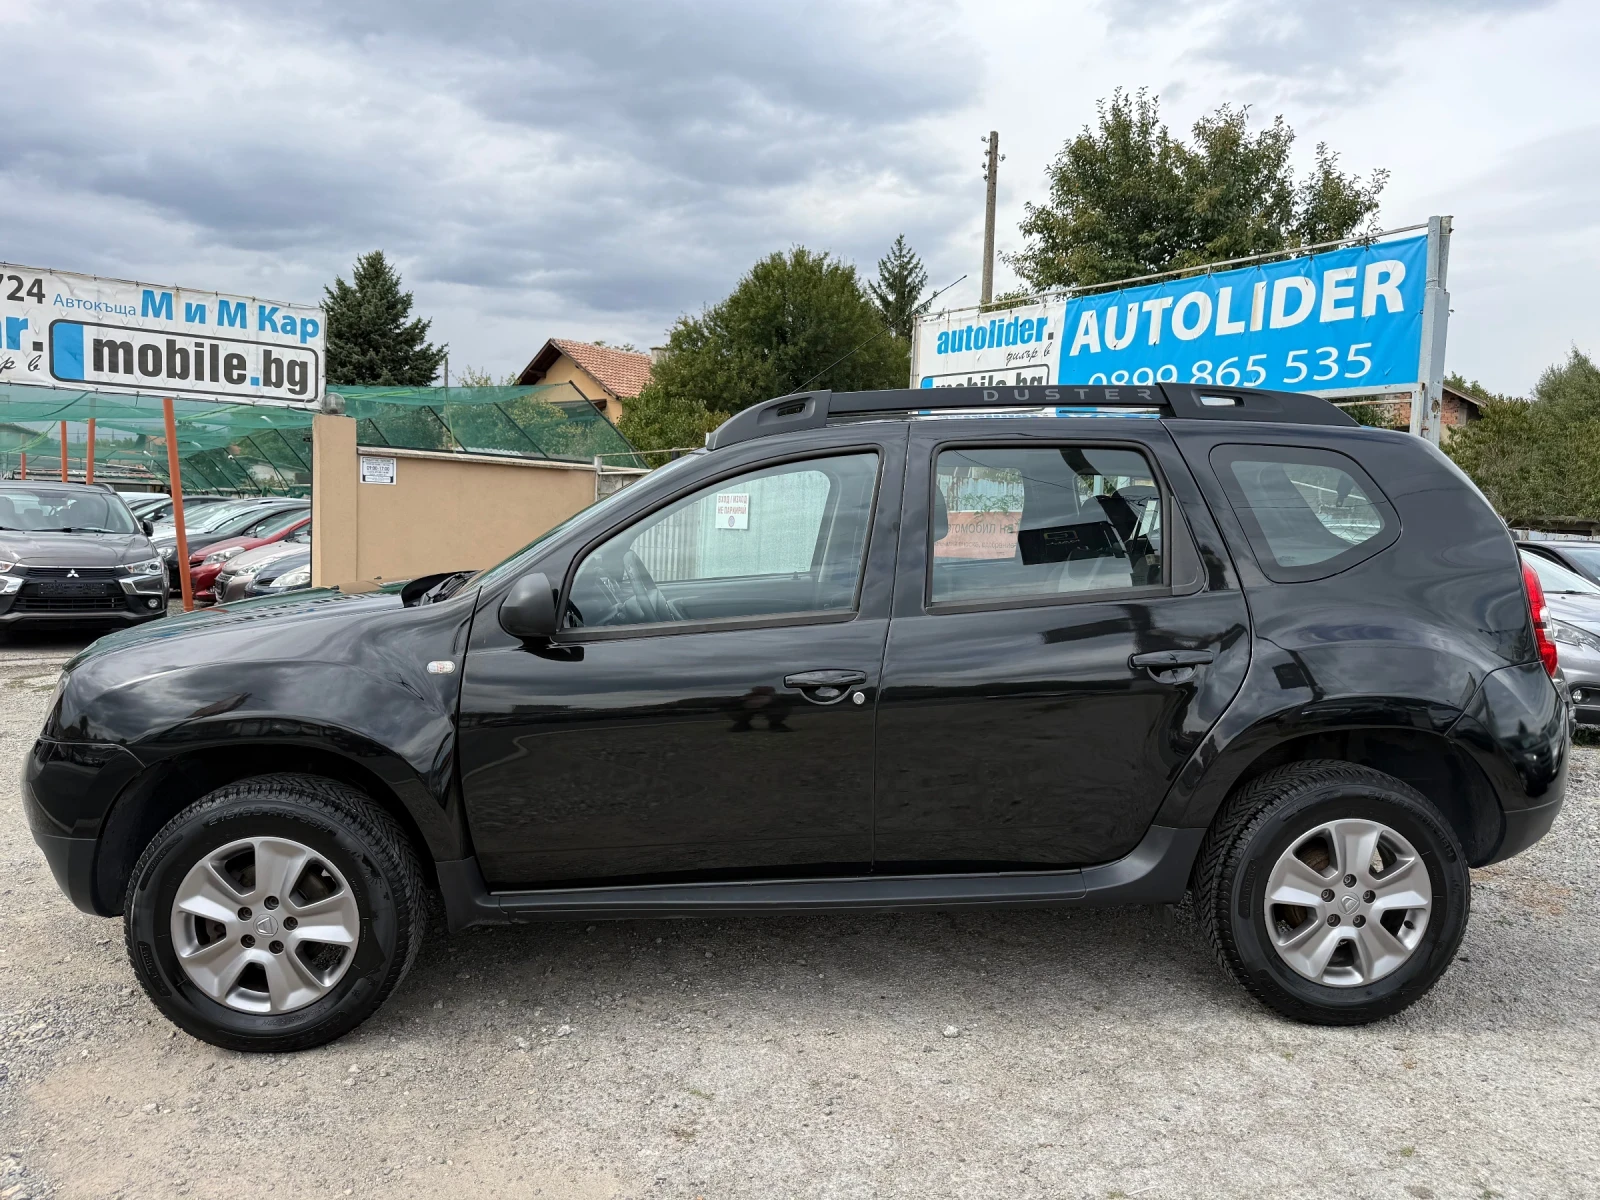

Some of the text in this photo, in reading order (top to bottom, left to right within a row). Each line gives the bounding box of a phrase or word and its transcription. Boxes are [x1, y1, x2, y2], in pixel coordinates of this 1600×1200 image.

[0, 274, 45, 304] 24
[1070, 260, 1406, 357] AUTOLIDER
[0, 316, 43, 352] r.
[53, 289, 320, 344] Автокъща М и М Кар
[937, 316, 1055, 355] autolider.
[93, 338, 309, 395] mobile.bg
[1190, 353, 1267, 387] 865
[1283, 342, 1372, 383] 535
[983, 388, 1153, 402] DUSTER
[718, 506, 723, 514] НЕ
